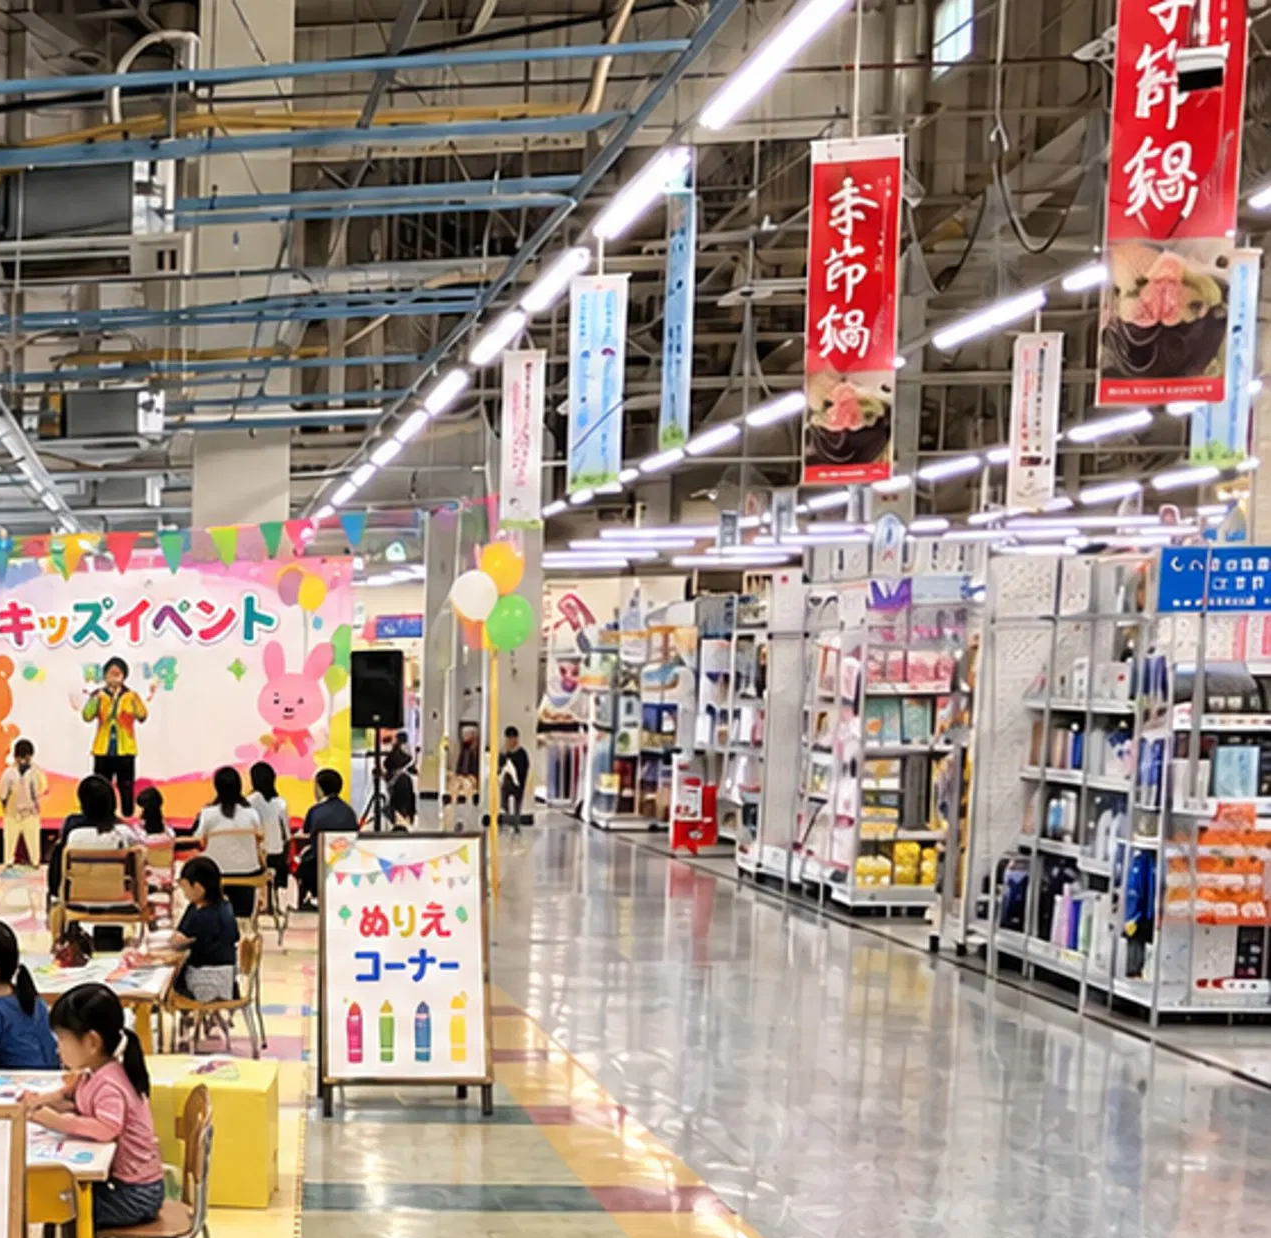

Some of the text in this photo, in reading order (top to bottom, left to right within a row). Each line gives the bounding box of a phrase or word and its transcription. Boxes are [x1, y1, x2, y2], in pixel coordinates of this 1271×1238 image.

[358, 902, 452, 938] ぬりえ
[354, 949, 460, 982] コーナー
